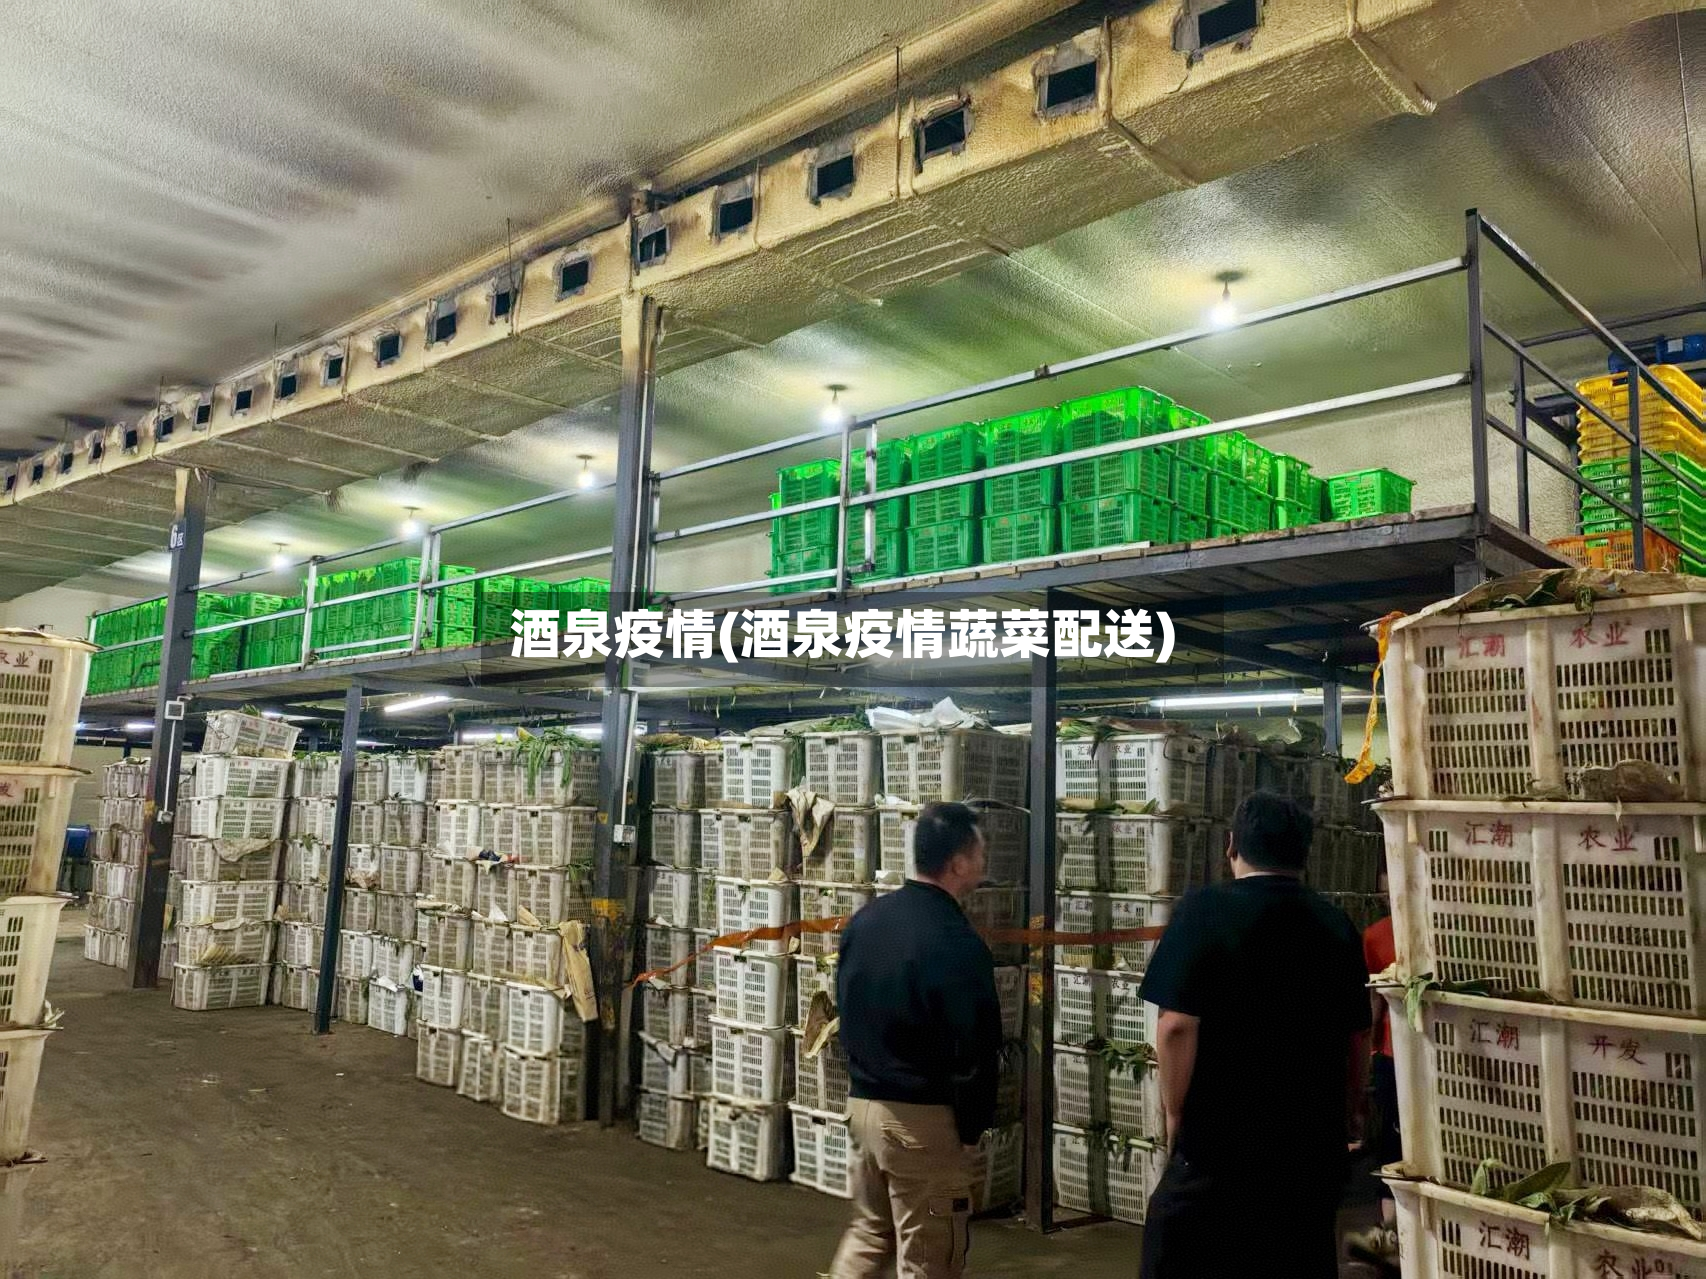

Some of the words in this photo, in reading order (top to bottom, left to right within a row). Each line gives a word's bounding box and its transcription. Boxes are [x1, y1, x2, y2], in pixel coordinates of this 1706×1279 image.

[1457, 633, 1506, 658] 汇潮
[1569, 621, 1630, 649] 农业
[1464, 820, 1514, 848] 汇潮
[1578, 825, 1639, 852] 农业
[1470, 1018, 1520, 1051] 汇潮
[1588, 1035, 1646, 1066] 开发
[1480, 1220, 1530, 1261] 汇潮
